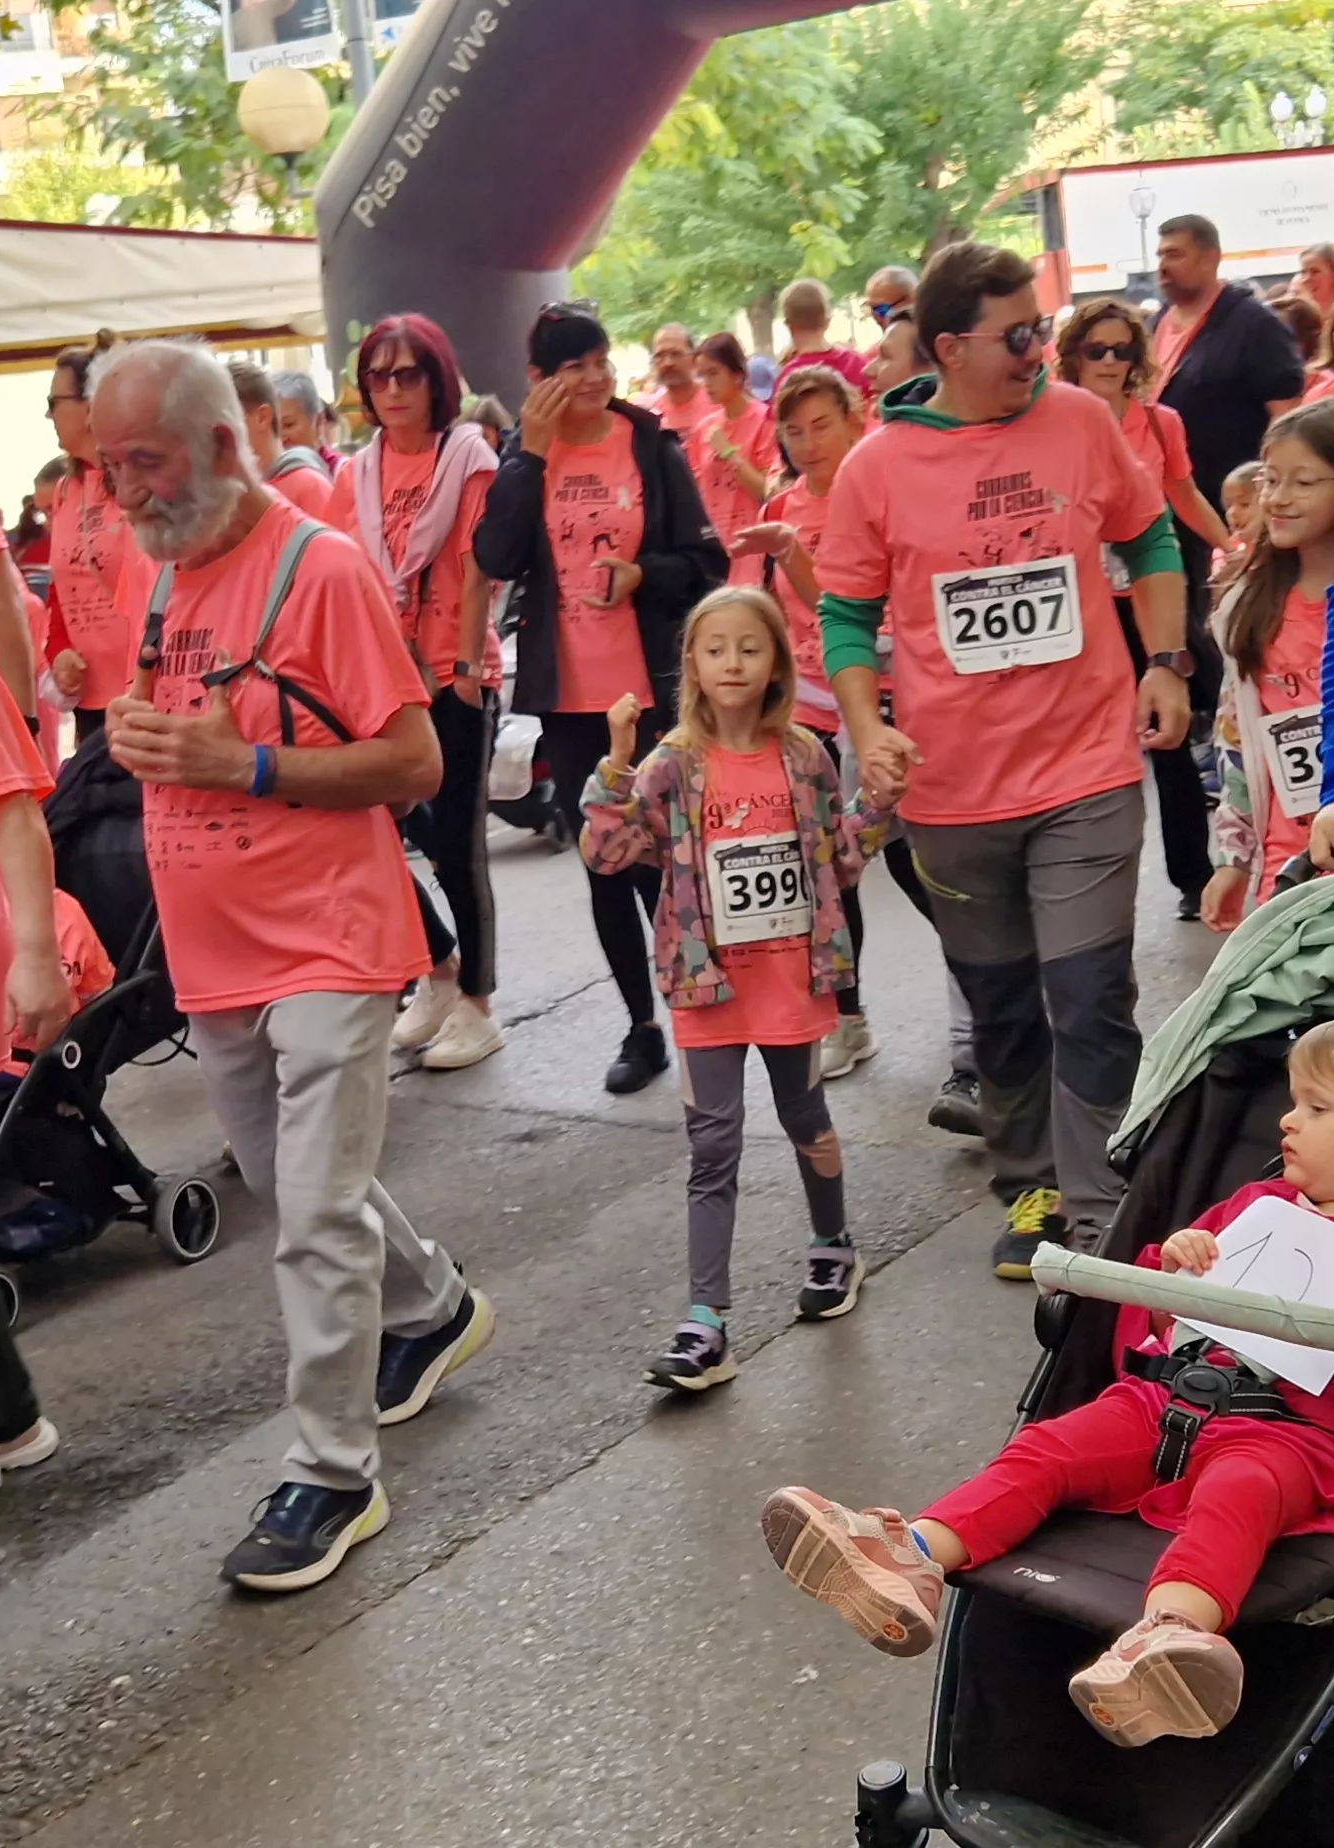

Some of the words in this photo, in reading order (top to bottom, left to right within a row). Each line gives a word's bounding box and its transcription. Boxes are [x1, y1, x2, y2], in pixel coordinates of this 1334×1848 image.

[352, 158, 408, 228] Pisa
[394, 85, 461, 158] bien,
[447, 9, 499, 73] vive
[952, 593, 1064, 645] 2607
[735, 792, 794, 810] CÁNCE
[723, 854, 771, 870] CONTRA
